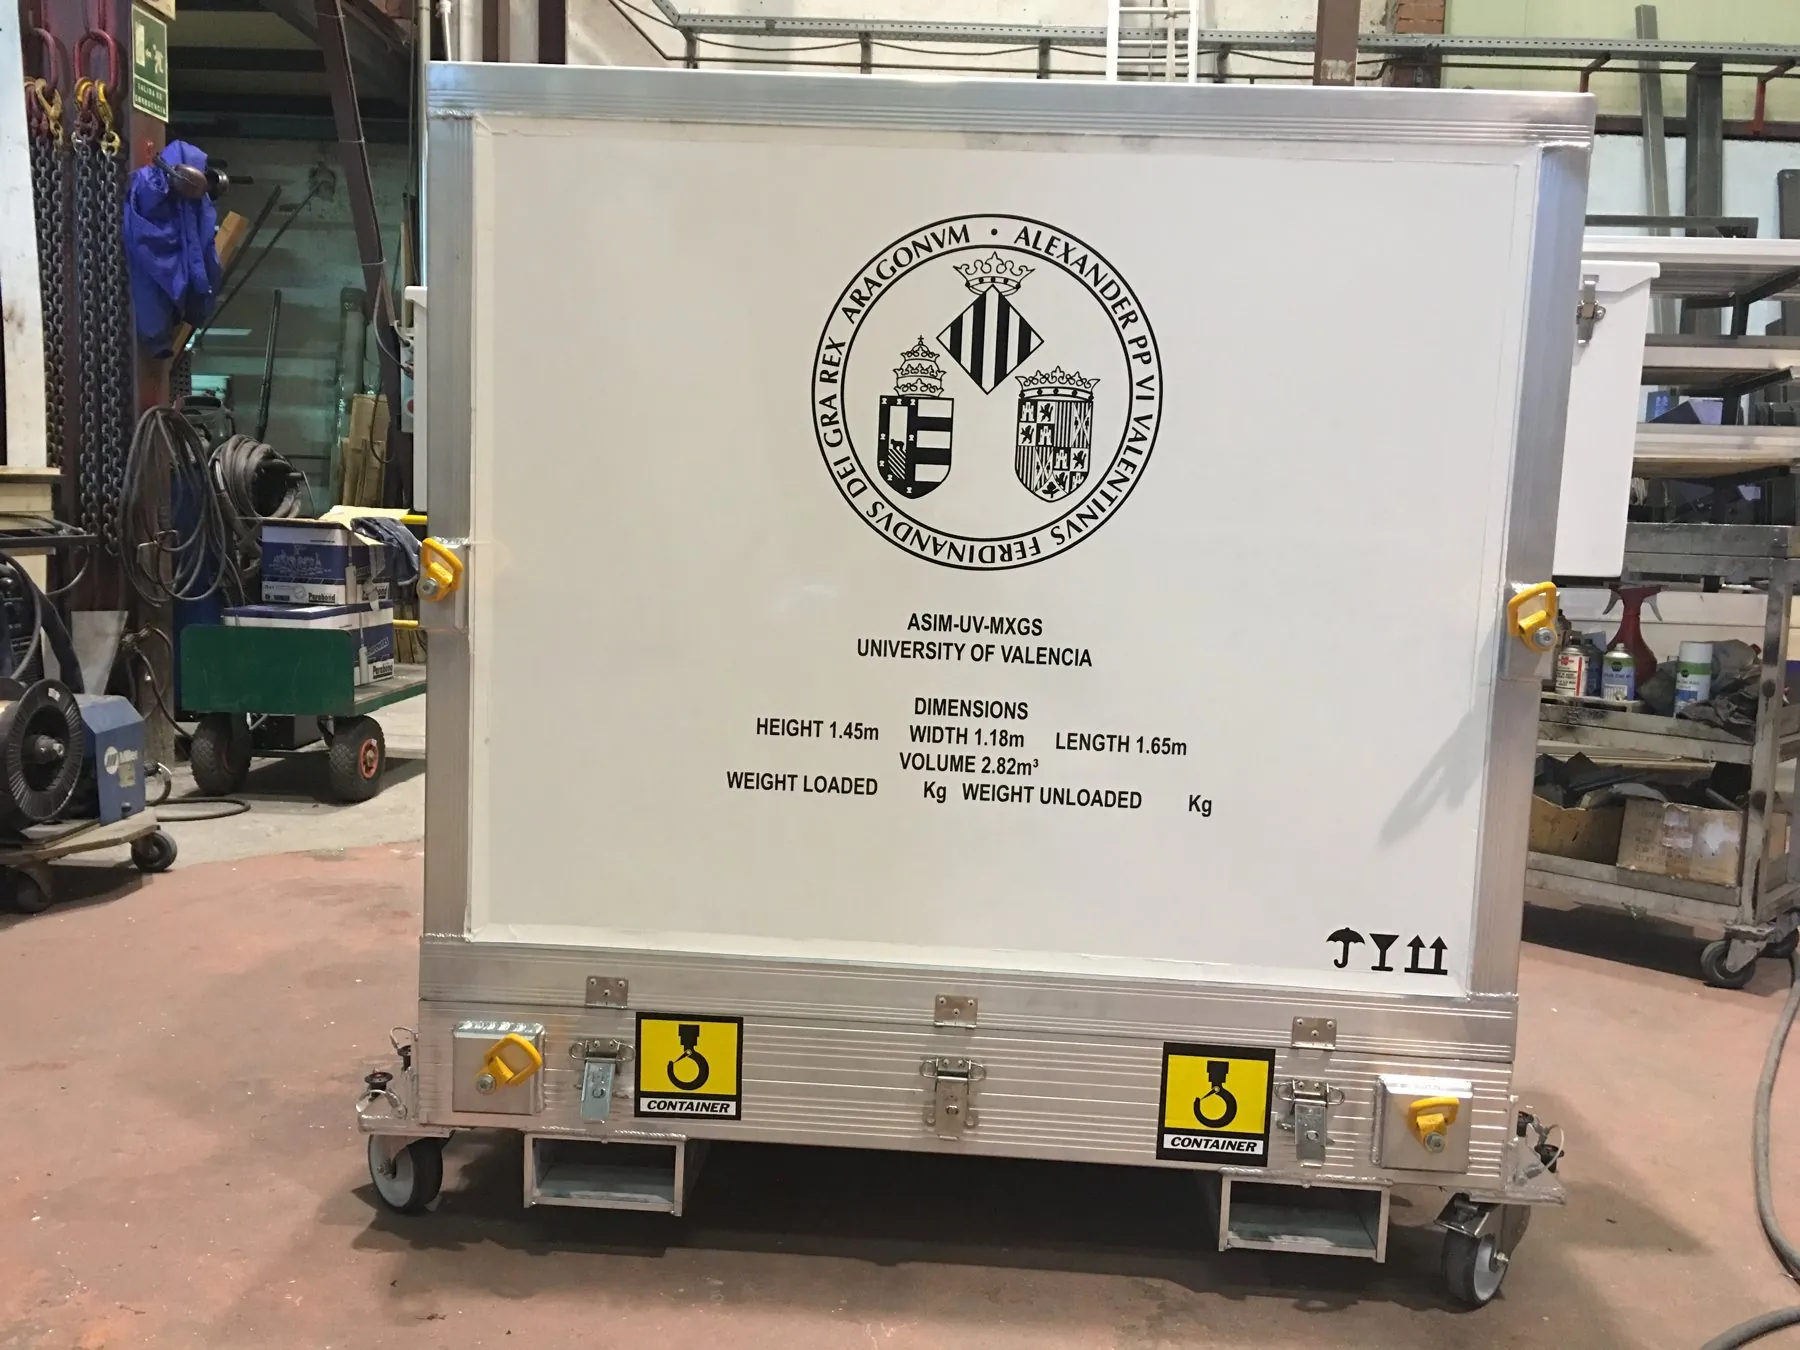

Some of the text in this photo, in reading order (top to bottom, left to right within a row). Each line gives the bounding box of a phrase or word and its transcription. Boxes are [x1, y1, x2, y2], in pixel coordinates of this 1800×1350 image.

[818, 223, 1155, 564] ALEXANDER PP VI VALENTINVS FERDINANDVS DEI GRA REX ARAGONVM
[907, 612, 1043, 637] ASIM-UV-MXGS
[857, 638, 1093, 667] UNIVERSITY OF VALENCIA
[914, 697, 1029, 721] DIMENSIONS
[756, 717, 1187, 756] HEIGHT 1.45m WIDTH 1.18m LENGTH 1.65m
[899, 751, 1039, 776] VOLUME 2.82m³
[726, 770, 1212, 818] WEIGHT LOADED Kg WEIGHT UNLOADED Kg
[646, 1100, 731, 1114] CONTAINER
[1169, 1135, 1258, 1153] CONTAINER
